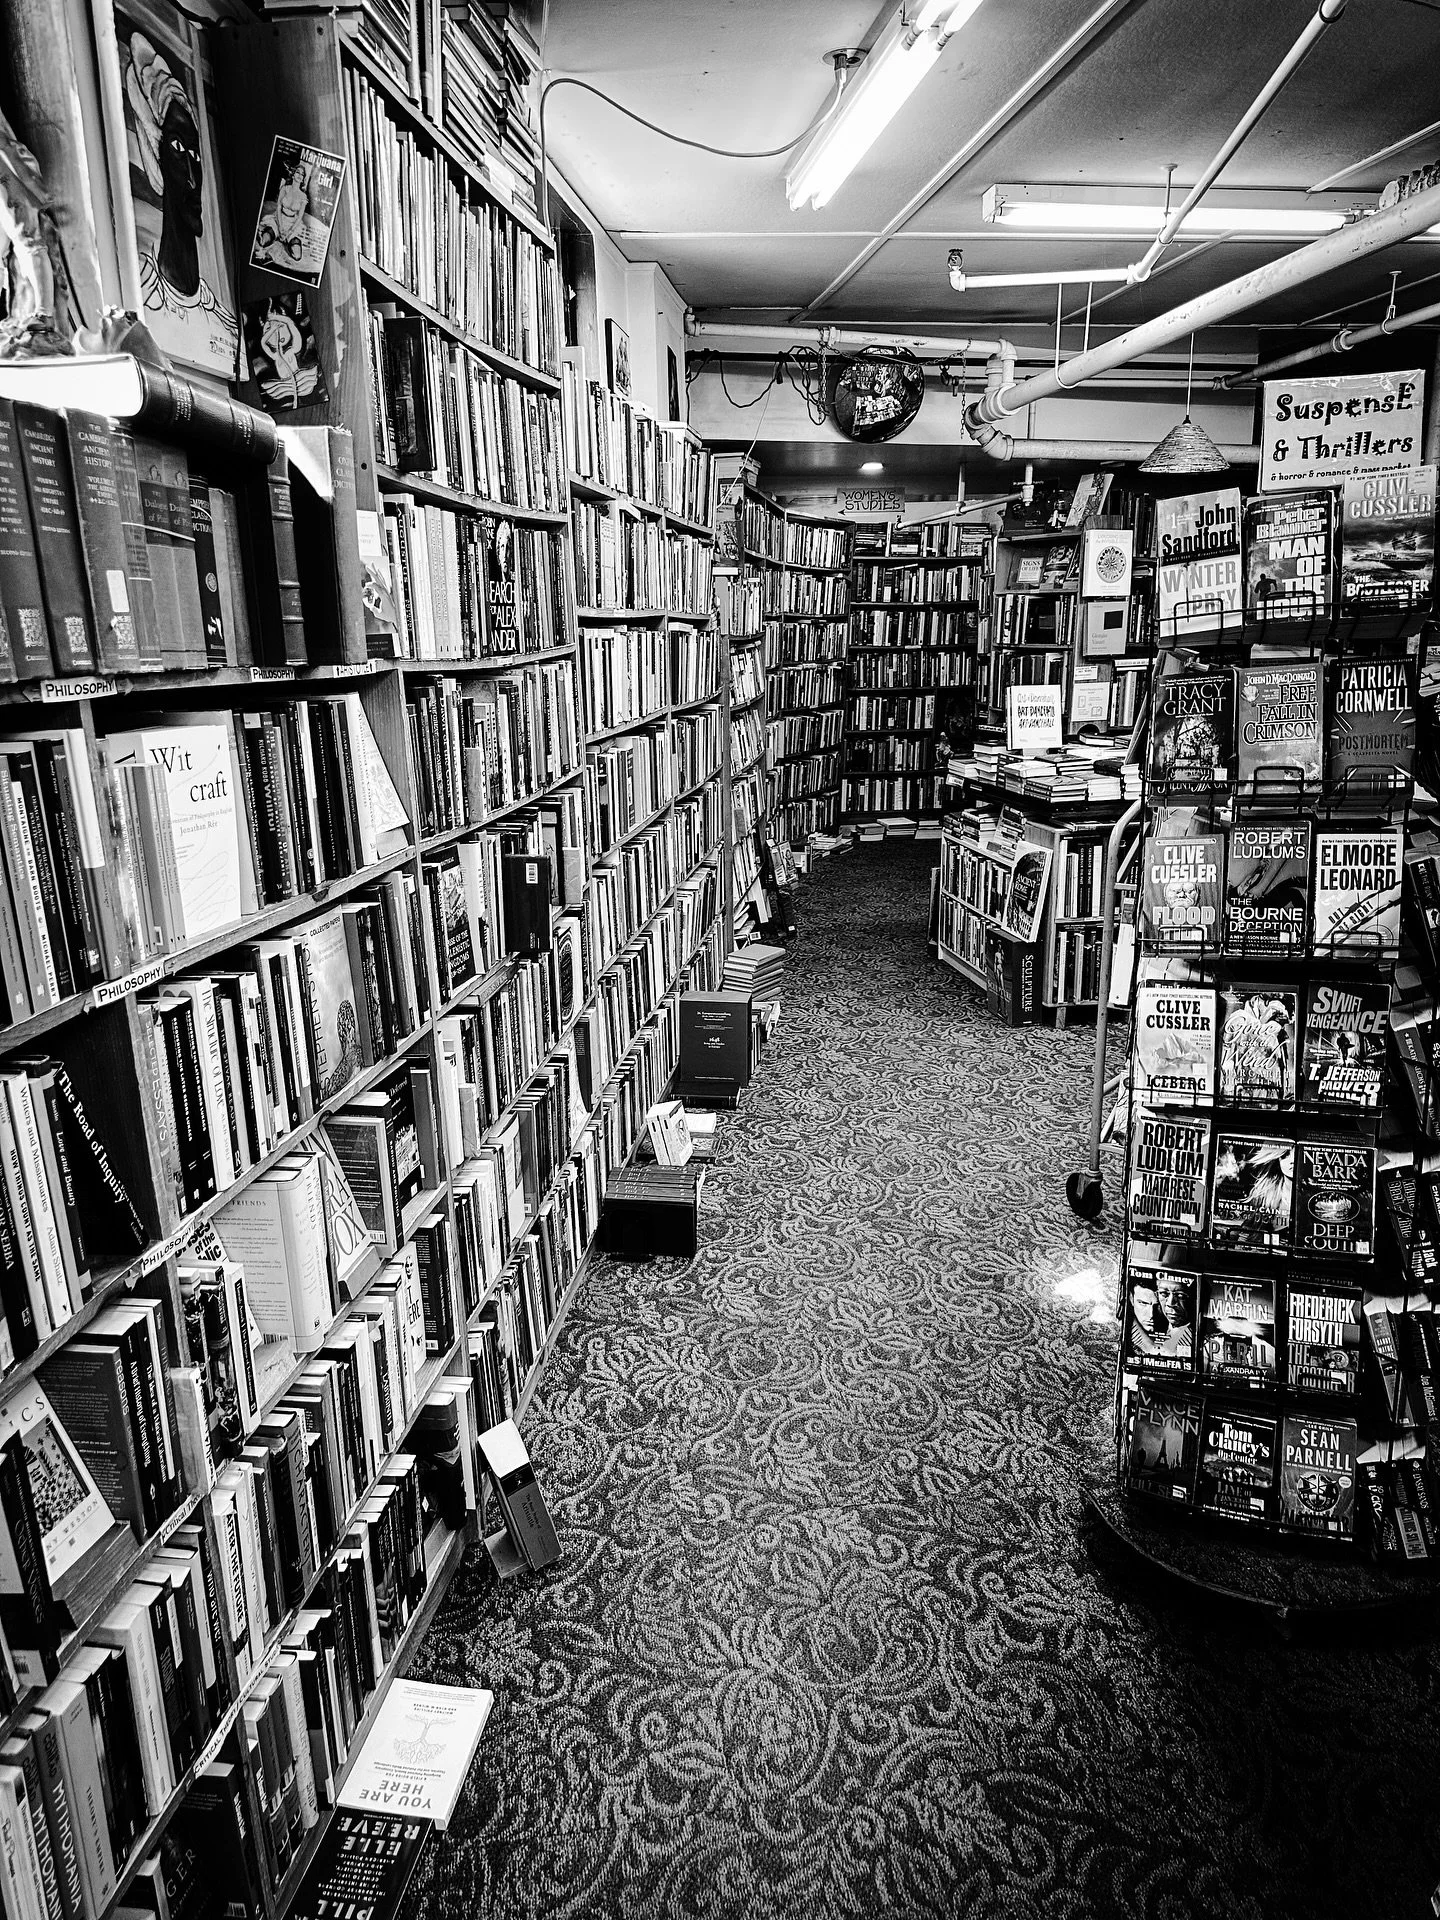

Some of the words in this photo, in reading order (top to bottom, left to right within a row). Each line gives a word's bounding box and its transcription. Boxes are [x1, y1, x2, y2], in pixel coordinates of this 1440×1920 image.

[300, 148, 342, 173] Marijuana
[318, 172, 334, 189] Girl
[30, 443, 54, 455] ANCIENT
[1272, 438, 1290, 462] &
[1296, 430, 1415, 460] Thrillers
[1278, 471, 1307, 481] horror
[1316, 469, 1351, 478] romance
[841, 489, 896, 500] WOMEN'S
[845, 499, 901, 511] STUDIES
[1195, 503, 1236, 528] John
[1274, 508, 1325, 525] Peter
[1348, 493, 1431, 520] CUSSLER
[1162, 522, 1237, 556] Sandford
[1256, 518, 1327, 539] Blauner
[1268, 535, 1326, 561] MAN
[1163, 560, 1237, 594] WNTER
[1296, 555, 1326, 577] OF
[1281, 575, 1326, 597] THE
[1353, 575, 1372, 583] THE
[1256, 596, 1325, 620] HOUR
[252, 667, 295, 679] PHILOSOPHY
[1243, 674, 1266, 687] JOHN
[1341, 663, 1408, 690] PATRICIA
[44, 680, 114, 698] PHILOSOPHY
[1165, 683, 1225, 701] TRACY
[1278, 683, 1317, 704] FREE
[1336, 687, 1412, 713] CORNWELL
[1163, 697, 1227, 716] GRANT
[1257, 703, 1296, 724] FALL
[1297, 703, 1318, 722] IN
[1243, 721, 1318, 745] CRIMSON
[1338, 733, 1409, 750] POSTMORTEM
[150, 745, 193, 774] Wit
[190, 770, 228, 803] craft
[179, 825, 206, 837] Jonathan
[1233, 831, 1305, 845] ROBERT
[1163, 845, 1205, 864] CLIVE
[1232, 846, 1306, 859] LUDLUM'S
[1320, 844, 1397, 866] ELMORE
[1016, 873, 1037, 888] ANCIENT
[1151, 864, 1217, 883] CUSSLER
[1320, 868, 1397, 891] LEONARD
[16, 797, 30, 846] MONTAIGNE
[27, 859, 36, 881] BARN
[32, 885, 41, 911] BOOTS
[40, 934, 53, 970] MICHAEL
[47, 971, 57, 998] PERRY
[1231, 897, 1252, 906] THE
[1152, 905, 1216, 925] FLOOD
[1229, 907, 1303, 921] BOURNE
[1328, 907, 1346, 924] OUT
[1349, 900, 1374, 925] SIGHT
[309, 921, 328, 938] COLLECTED
[1229, 921, 1303, 933] DECEPTION
[99, 966, 162, 1002] PHILOSOPHY
[1024, 954, 1034, 1013] SCULPTURE
[1156, 999, 1201, 1015] CLIVE
[1312, 986, 1363, 1014] SWIFT
[1145, 1014, 1211, 1031] CUSSLER
[1223, 1009, 1283, 1044] Gone
[1306, 1010, 1390, 1035] VENGEANCE
[204, 1015, 219, 1064] Structure
[214, 1079, 225, 1110] Love
[1221, 1039, 1291, 1070] Wind
[1146, 1074, 1206, 1091] ICEBERG
[1308, 1062, 1321, 1081] T.
[1323, 1065, 1381, 1082] JEFFERSON
[20, 1086, 31, 1126] Writers
[152, 1077, 168, 1141] ESSAYS
[228, 1094, 236, 1132] READER
[27, 1126, 38, 1147] and
[56, 1131, 66, 1153] Love
[58, 1070, 76, 1103] The
[73, 1101, 95, 1140] Road
[90, 1140, 104, 1156] of
[98, 1152, 126, 1203] Inquiry
[1142, 1122, 1206, 1154] ROBERT
[10, 1148, 20, 1169] HOW
[60, 1154, 71, 1174] and
[1137, 1144, 1205, 1176] LUDLUM
[1303, 1150, 1368, 1168] NEVADA
[32, 1147, 49, 1213] Missionaries
[1312, 1164, 1358, 1181] BARR
[14, 1170, 25, 1200] THINGS
[65, 1175, 76, 1207] Beauty
[1141, 1173, 1197, 1201] MATARESE
[20, 1202, 31, 1229] COUNT
[1218, 1202, 1255, 1212] RACHEL
[1258, 1206, 1288, 1216] CAINE
[203, 1232, 216, 1244] the
[1313, 1222, 1355, 1238] DEEP
[28, 1242, 36, 1259] THE
[32, 1260, 41, 1282] SAME
[1129, 1266, 1153, 1280] Tom
[1155, 1271, 1195, 1288] Clancy
[1223, 1284, 1253, 1303] KAT
[1207, 1298, 1269, 1321] MARTIN
[1289, 1292, 1356, 1324] FREDERICK
[1288, 1316, 1344, 1347] FORSYTH
[1208, 1339, 1272, 1367] PERIL
[1287, 1342, 1311, 1367] THE
[1166, 1360, 1192, 1371] FEAS
[114, 1358, 130, 1416] reasons
[134, 1390, 144, 1418] History
[1140, 1389, 1200, 1420] VINCE
[1137, 1406, 1199, 1436] FLYNN
[1208, 1430, 1270, 1458] Clancy's
[1221, 1422, 1253, 1444] Tom
[1300, 1428, 1340, 1451] SEAN
[1286, 1444, 1352, 1471] PARNELL
[165, 1506, 187, 1534] Critical
[226, 1514, 236, 1550] AFTER
[230, 1551, 239, 1571] THE
[232, 1571, 244, 1623] FUTURE
[194, 1738, 221, 1774] CRITICAL
[358, 1788, 394, 1803] ARE
[378, 1779, 424, 1795] HERE
[394, 1795, 432, 1809] YOU
[336, 1816, 421, 1840] REEVE
[52, 1778, 82, 1913] MYTHOMANIA
[340, 1835, 402, 1857] ELLE
[316, 1899, 375, 1920] PILL
